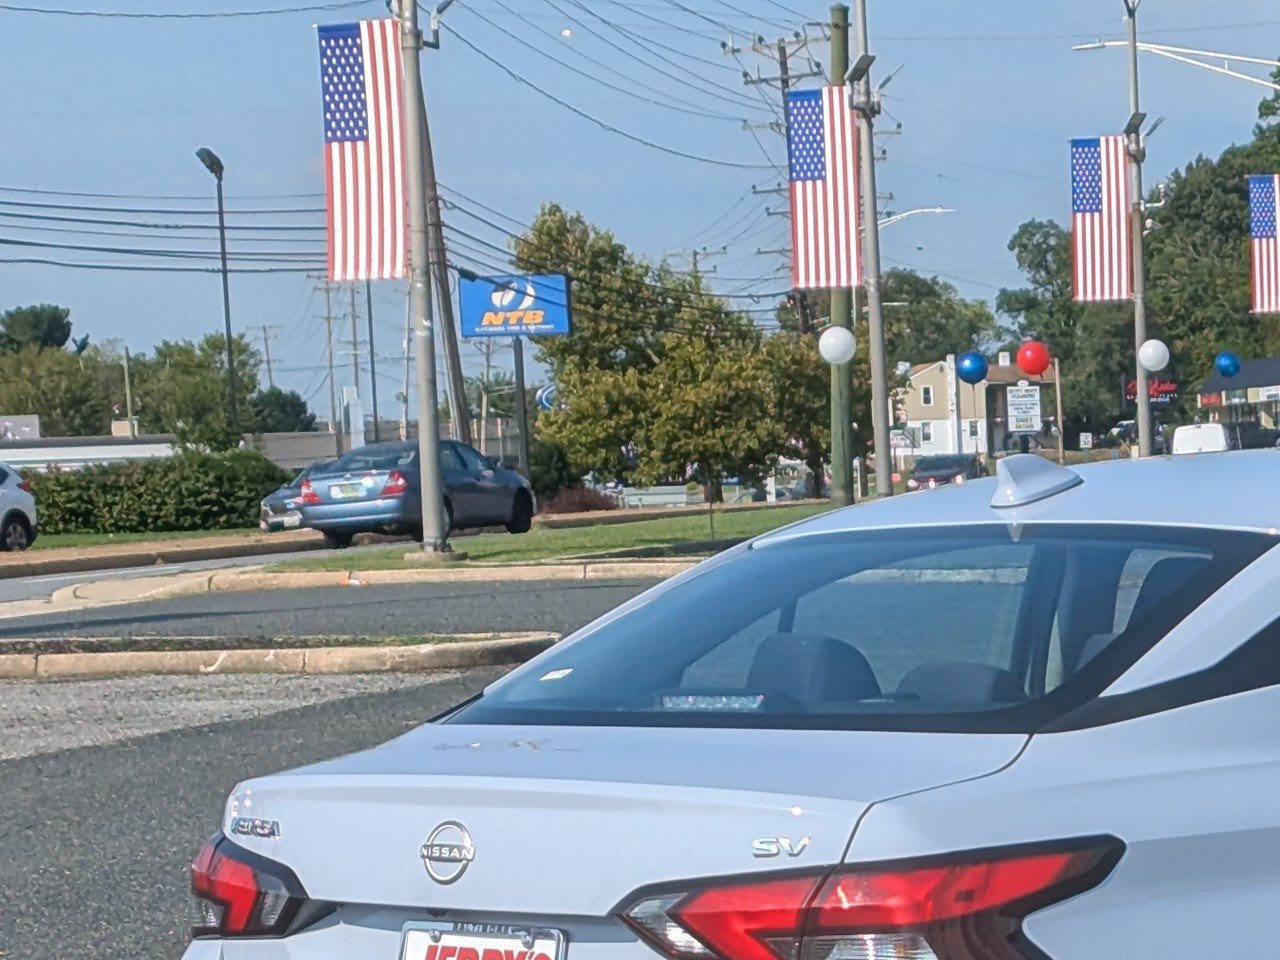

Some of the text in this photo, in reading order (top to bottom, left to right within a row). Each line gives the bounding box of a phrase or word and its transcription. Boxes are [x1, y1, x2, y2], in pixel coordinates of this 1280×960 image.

[482, 309, 545, 325] NTB
[421, 846, 475, 860] NISSAN
[751, 836, 811, 858] SV
